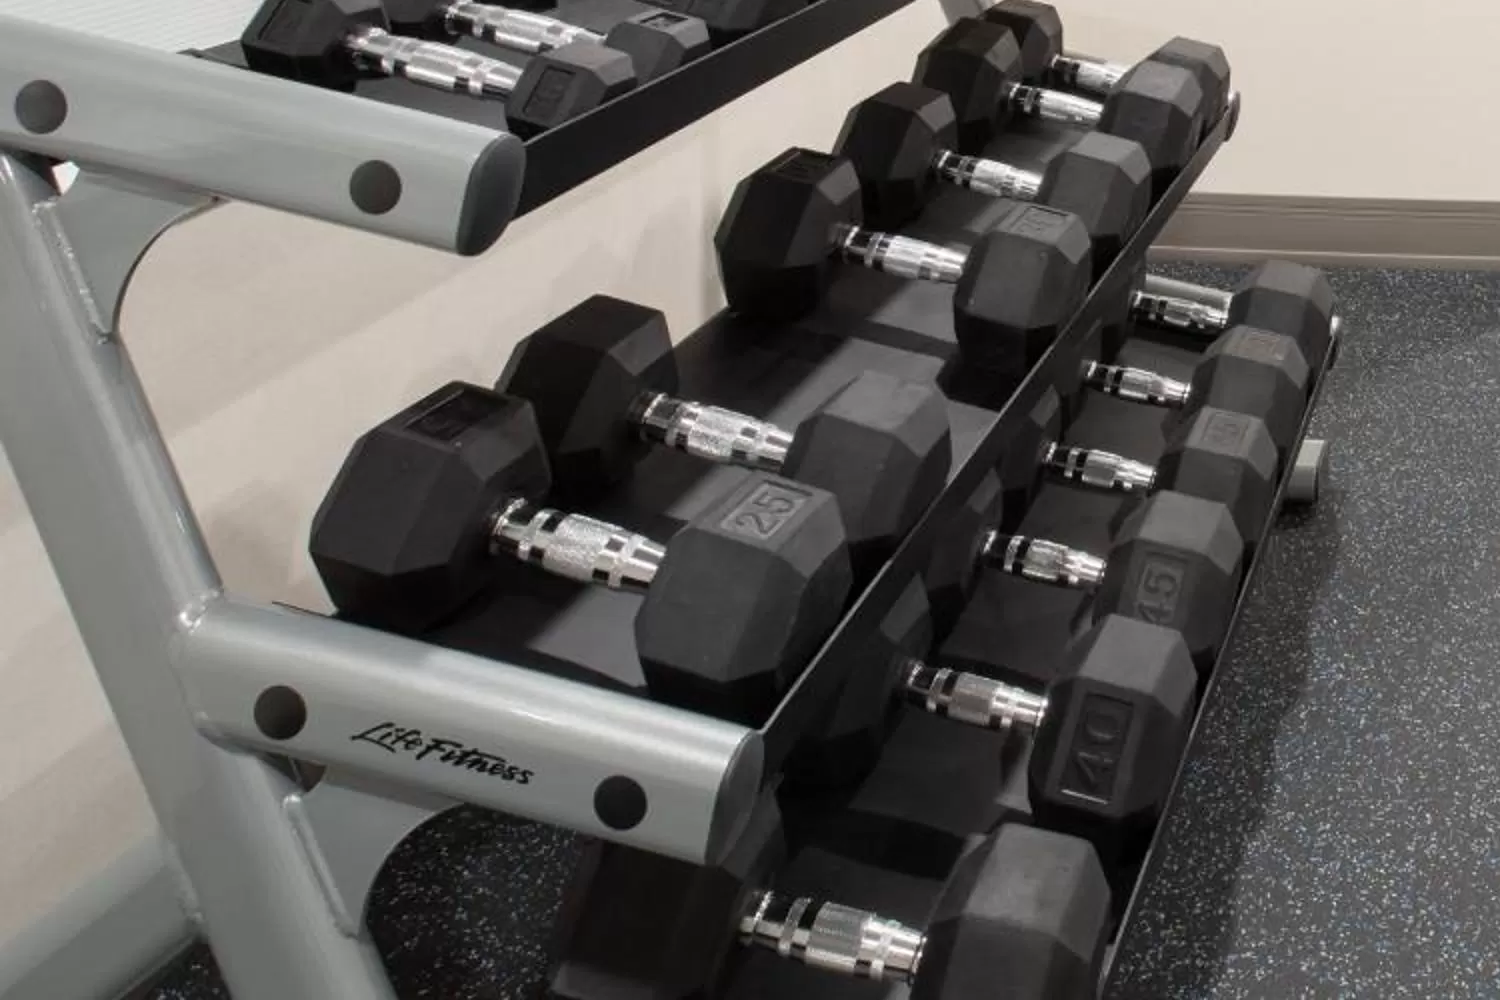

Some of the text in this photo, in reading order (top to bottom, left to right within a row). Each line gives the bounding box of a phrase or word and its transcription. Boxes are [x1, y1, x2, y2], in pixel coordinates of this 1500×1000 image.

[735, 491, 796, 535] 25
[1138, 566, 1179, 626] 45
[350, 721, 535, 785] Life Fitness
[1072, 704, 1121, 792] 40
